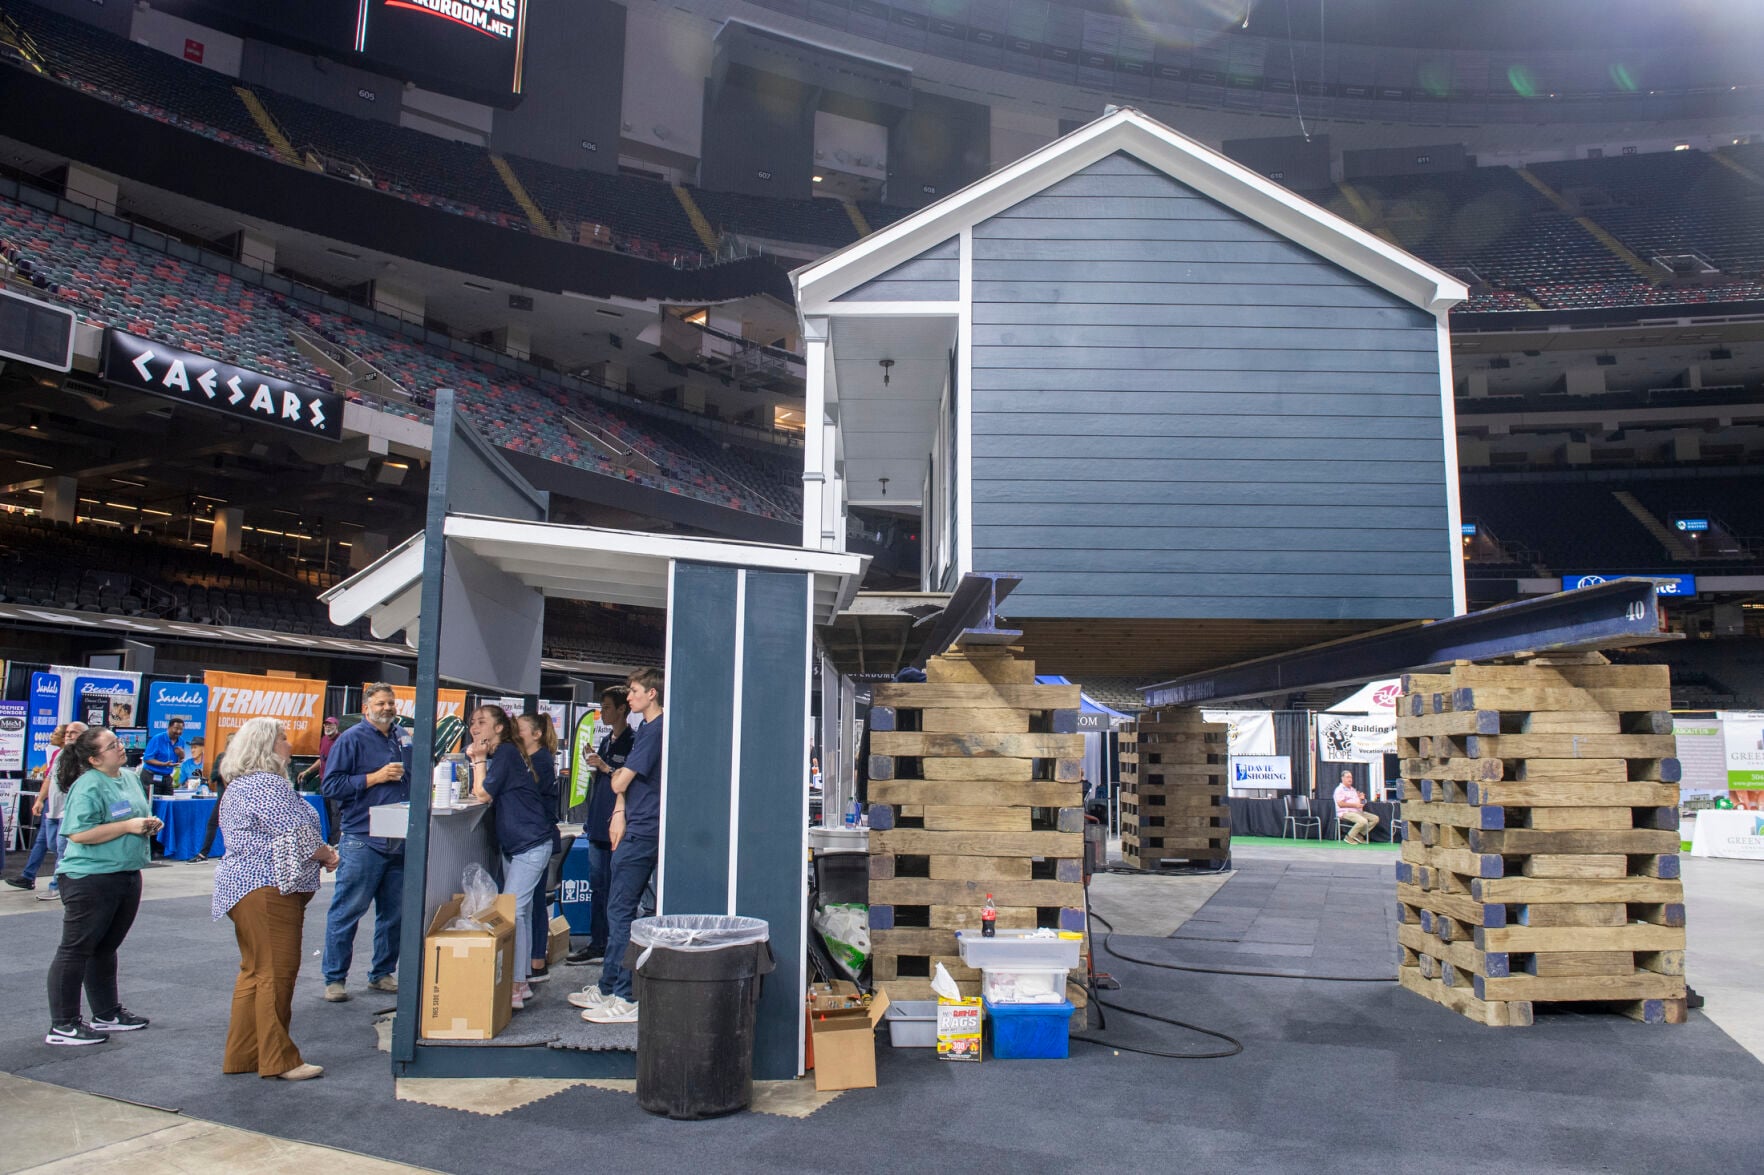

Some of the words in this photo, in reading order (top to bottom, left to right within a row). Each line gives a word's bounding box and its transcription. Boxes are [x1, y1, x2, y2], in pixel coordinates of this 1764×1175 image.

[358, 89, 375, 101] 605
[582, 141, 597, 151] 606
[758, 171, 771, 180] 607
[132, 350, 326, 428] CAESARS
[1625, 600, 1645, 621] 40
[81, 682, 130, 695] Beaches
[156, 688, 203, 704] Sandals
[208, 687, 319, 717] TERMINIX
[218, 717, 247, 728] LOCALLY
[294, 720, 308, 731] 1947
[1352, 724, 1389, 734] Building
[1329, 749, 1352, 760] HOPE
[1731, 751, 1764, 761] GREE
[434, 985, 440, 994] UP
[942, 1016, 977, 1028] RAGS
